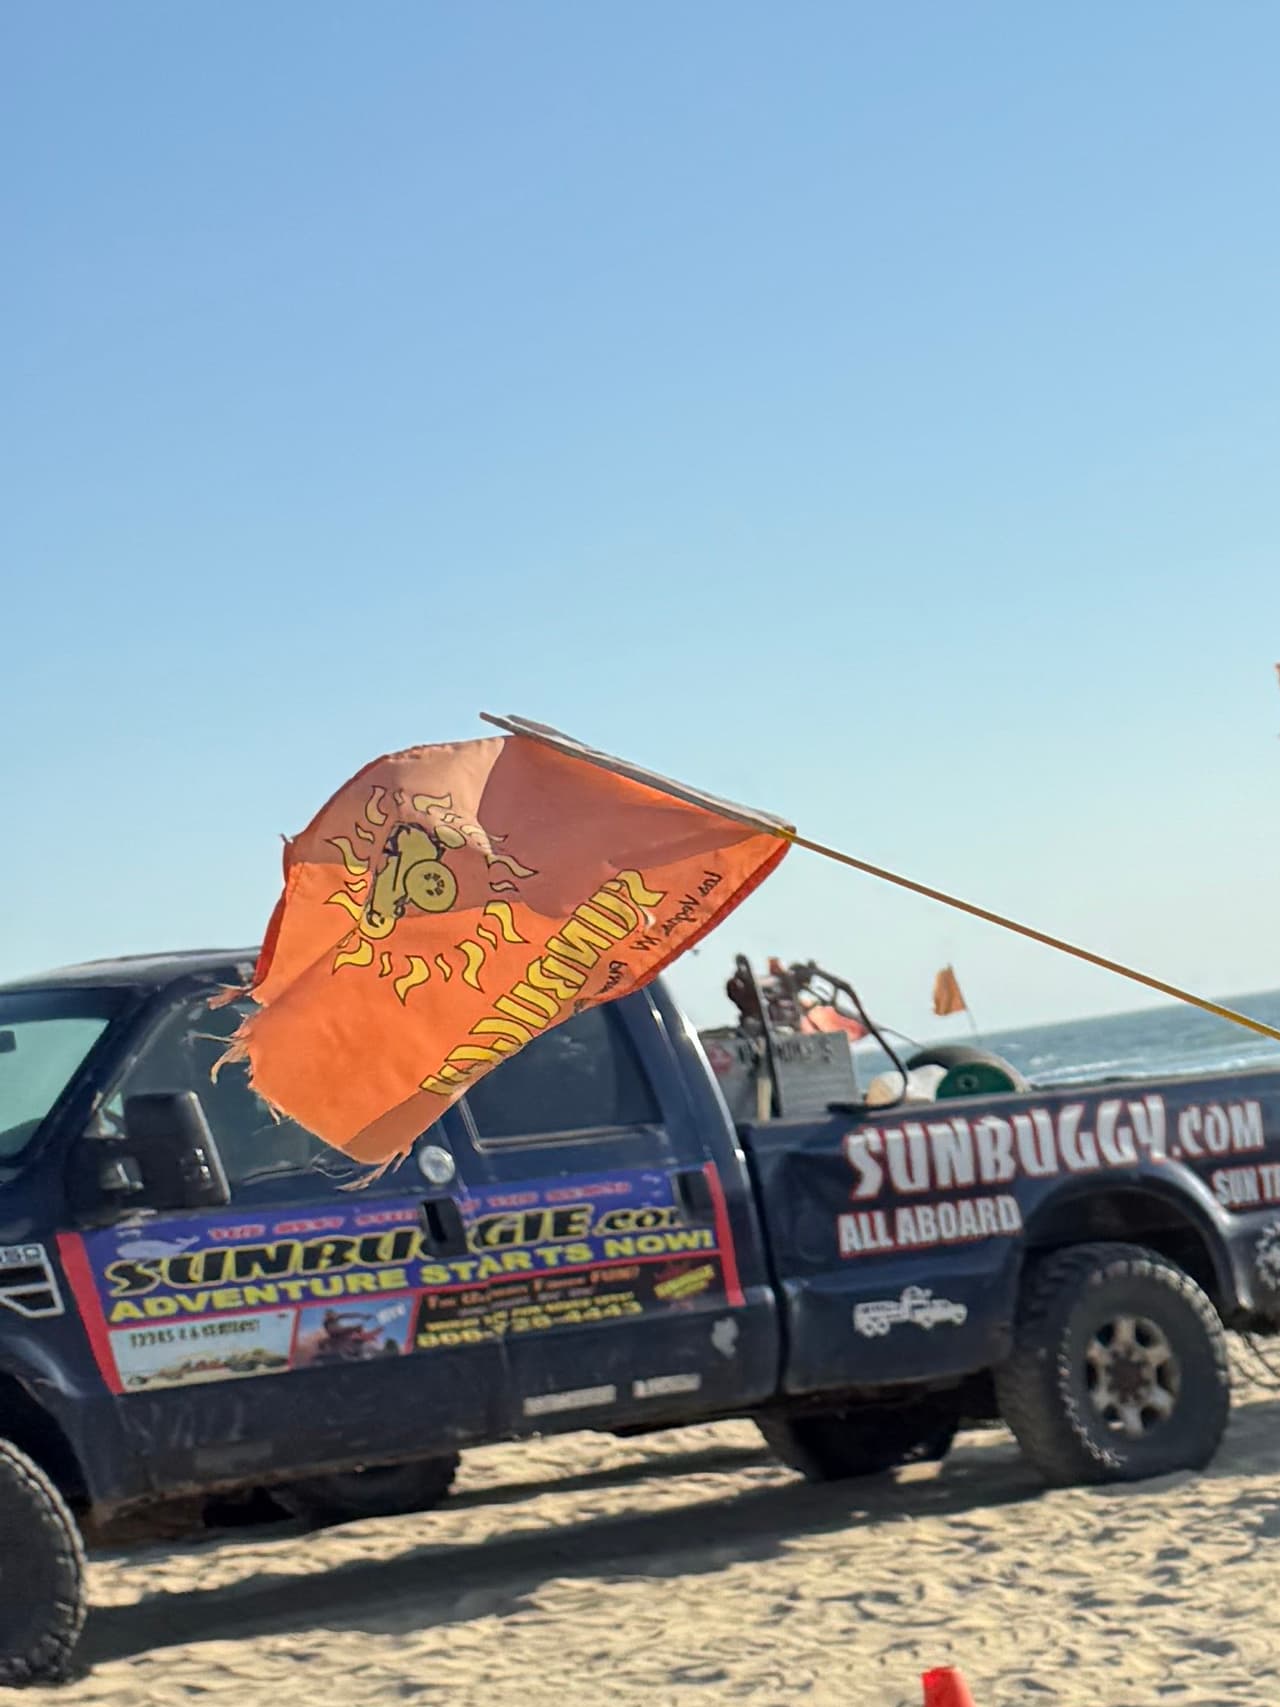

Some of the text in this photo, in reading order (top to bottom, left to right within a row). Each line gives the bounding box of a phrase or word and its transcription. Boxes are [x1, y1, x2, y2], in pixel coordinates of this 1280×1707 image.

[1212, 1166, 1260, 1208] SUN
[837, 1194, 1023, 1259] ALL ABOARD
[110, 1268, 408, 1322] ADVENTURE
[420, 1243, 593, 1284] STARTS
[605, 1229, 714, 1257] NOW!
